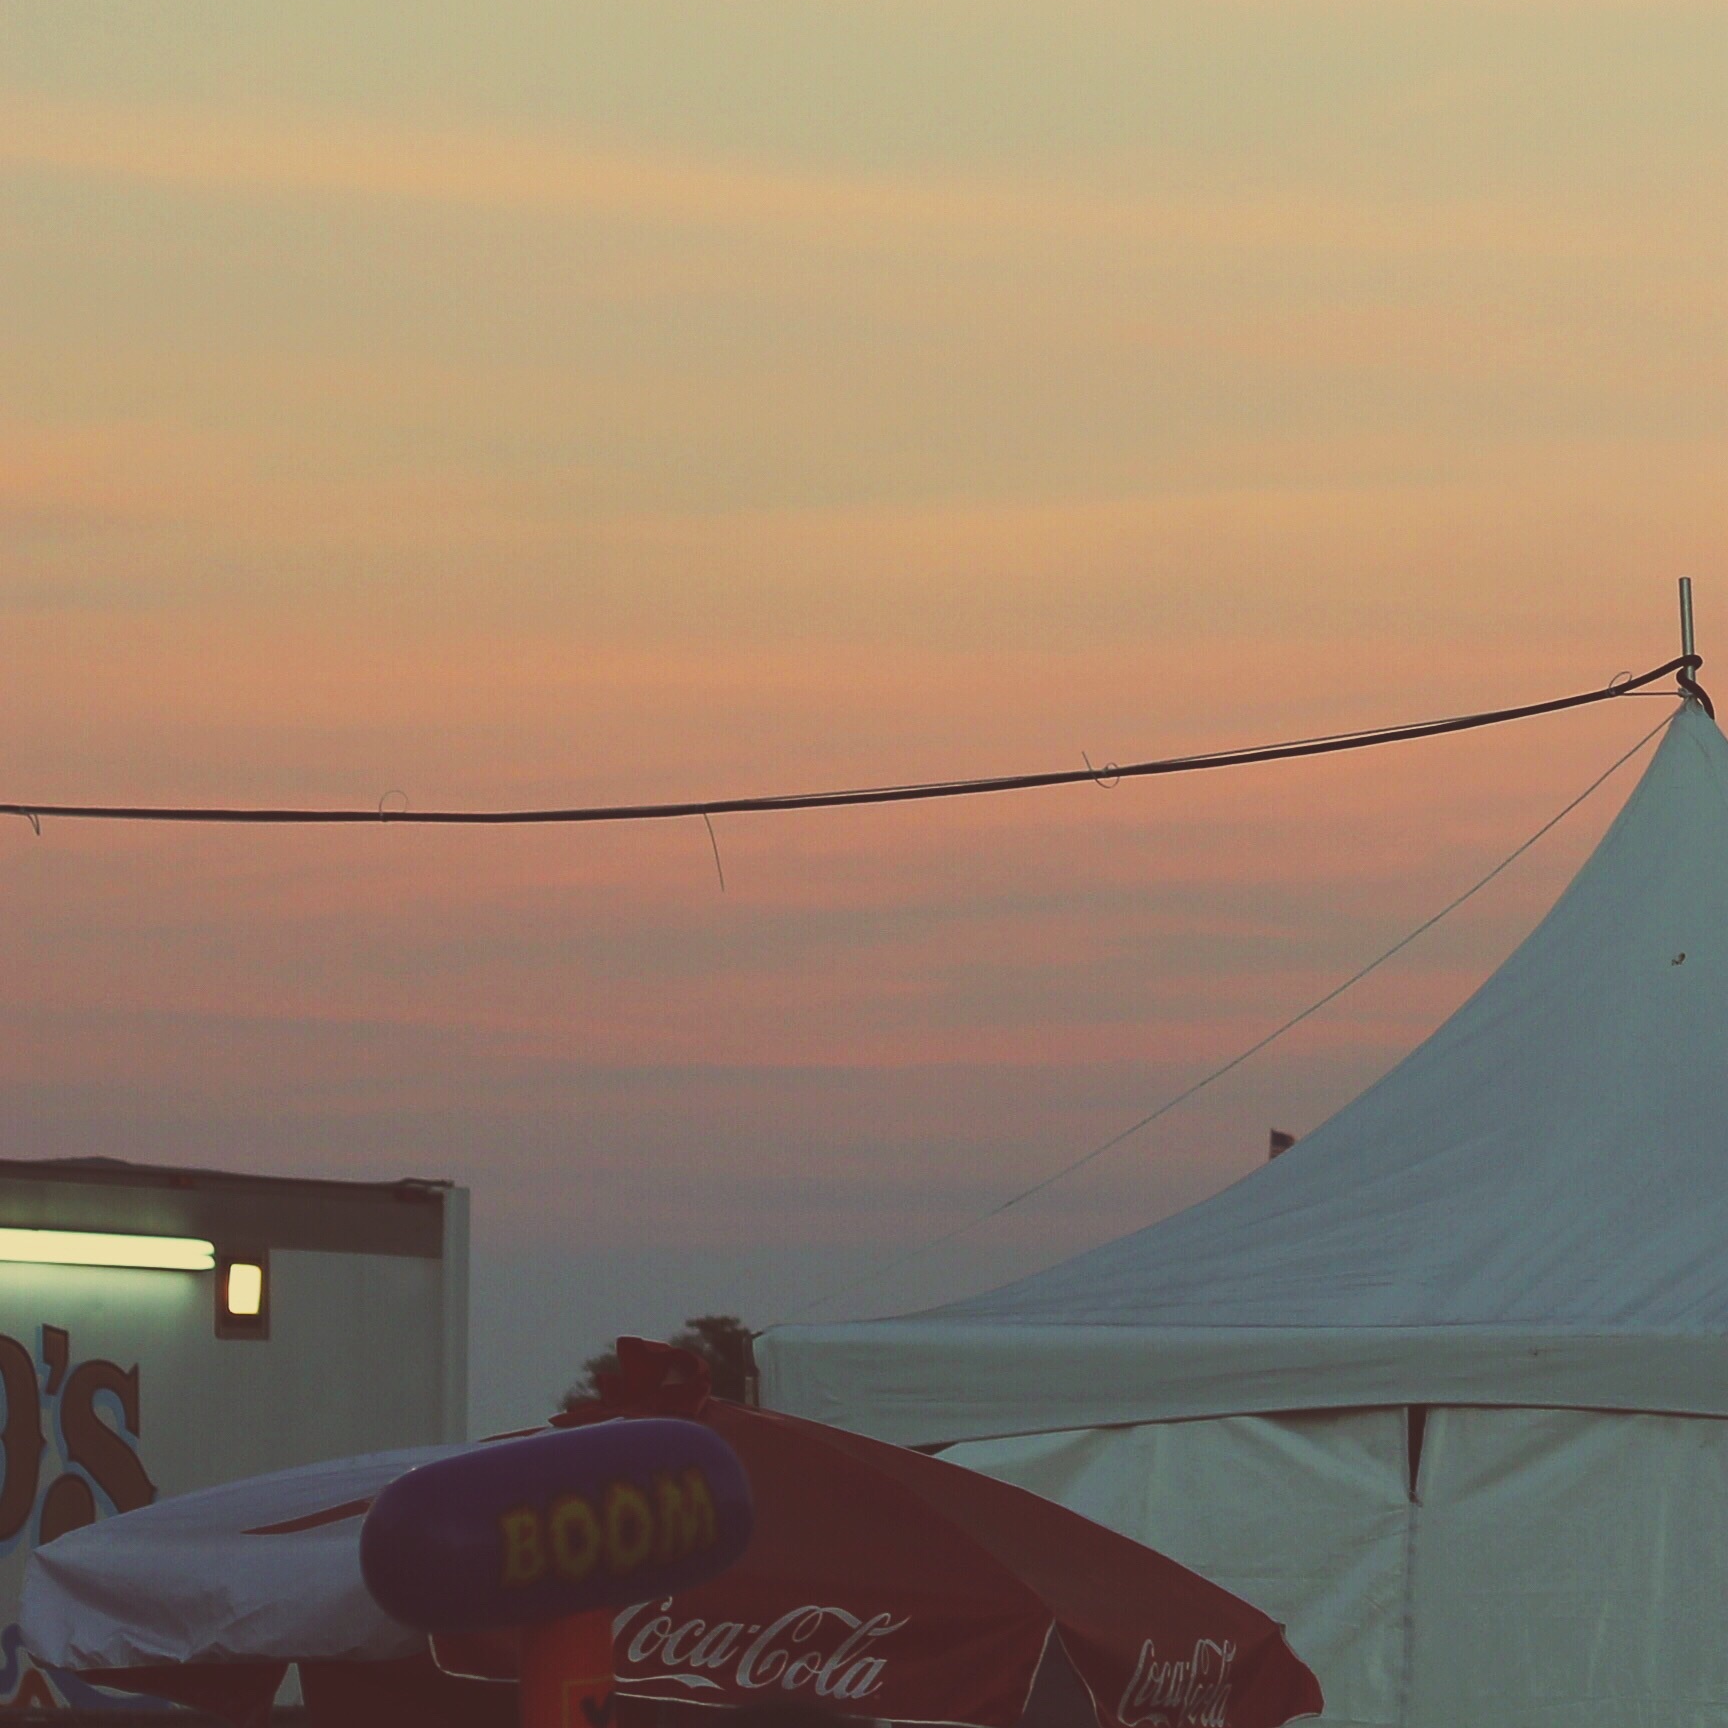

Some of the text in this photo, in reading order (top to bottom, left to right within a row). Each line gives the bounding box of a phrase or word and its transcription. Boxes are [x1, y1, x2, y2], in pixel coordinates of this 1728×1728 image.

[500, 1466, 717, 1586] BOOM
[613, 1595, 912, 1700] Coca-Cola
[1115, 1637, 1237, 1727] Coca-Cola
